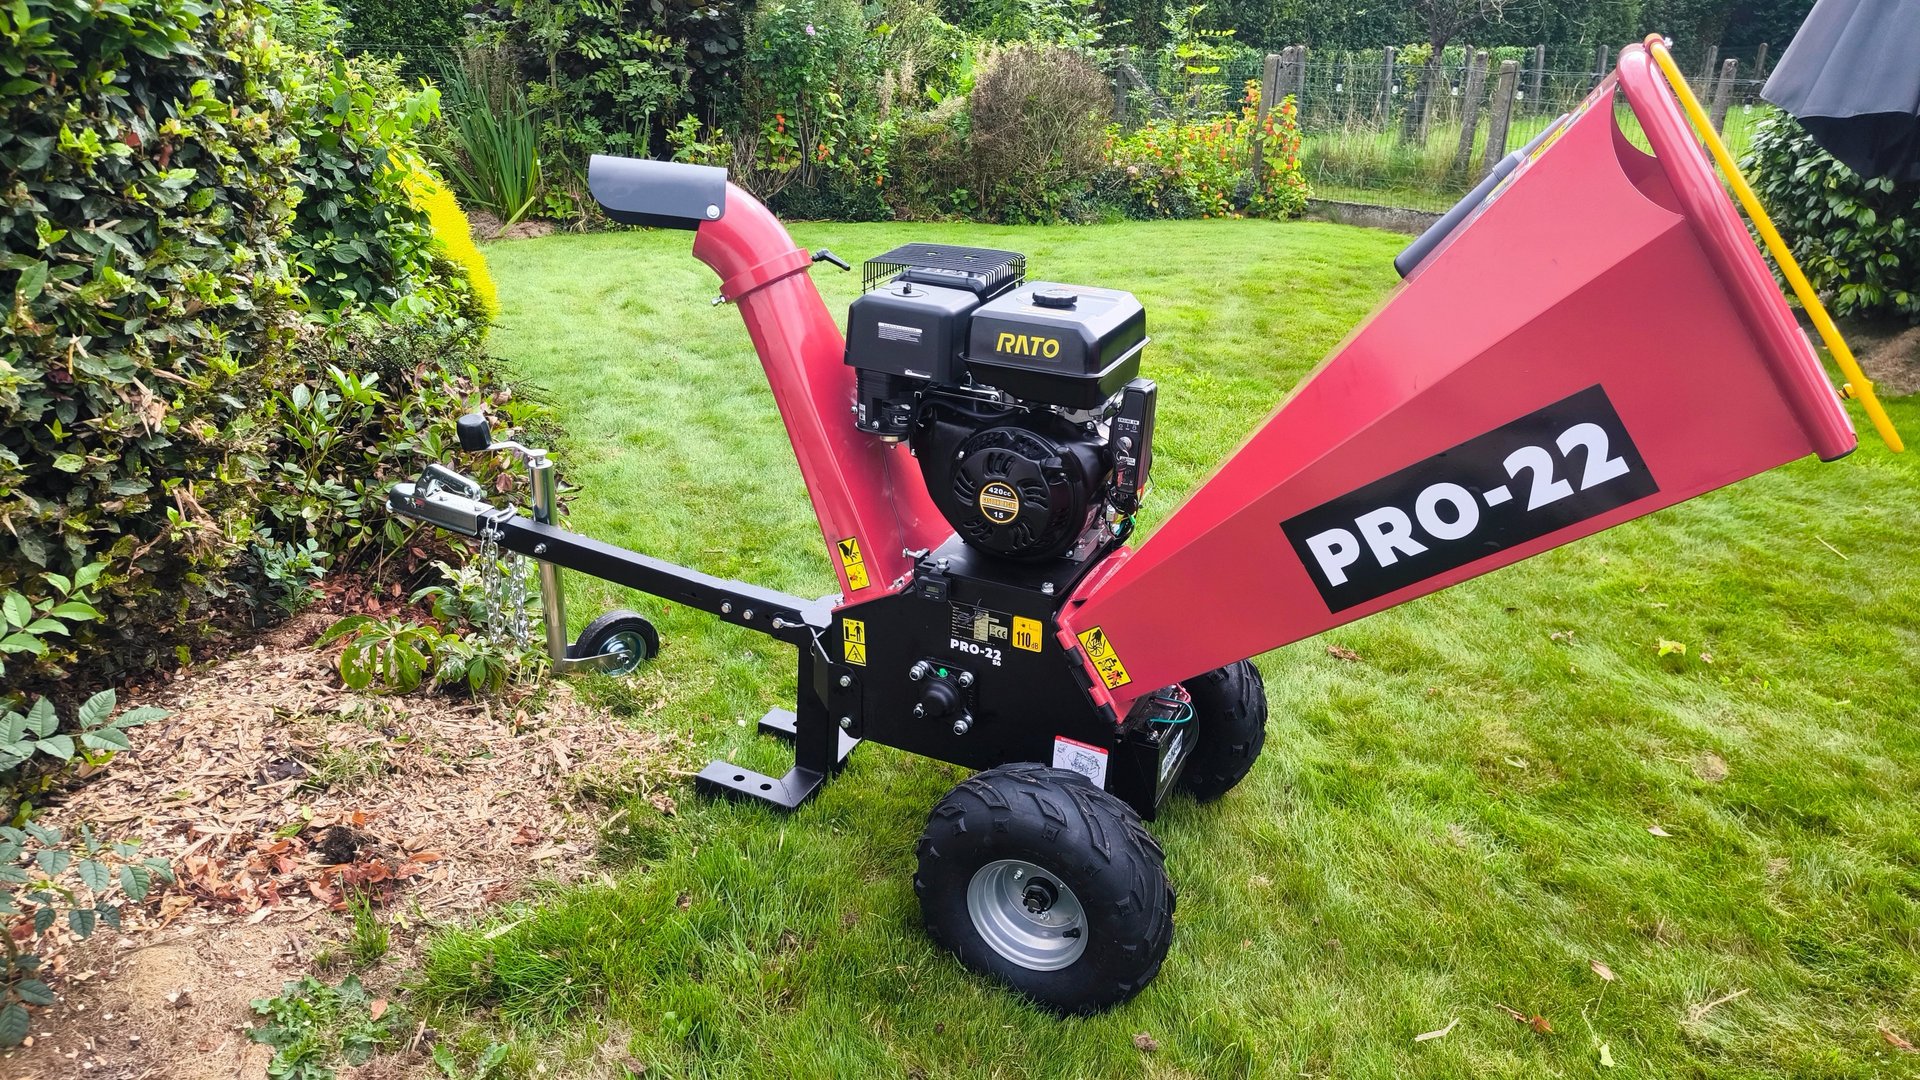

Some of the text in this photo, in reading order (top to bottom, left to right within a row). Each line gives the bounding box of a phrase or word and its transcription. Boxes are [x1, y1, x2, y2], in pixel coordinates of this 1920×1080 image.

[996, 333, 1060, 359] RATO
[988, 487, 1012, 497] 420cc
[993, 511, 1004, 519] 15
[1305, 422, 1630, 588] PRO-22
[950, 638, 1002, 661] PRO-22
[1016, 631, 1039, 650] 110 dB
